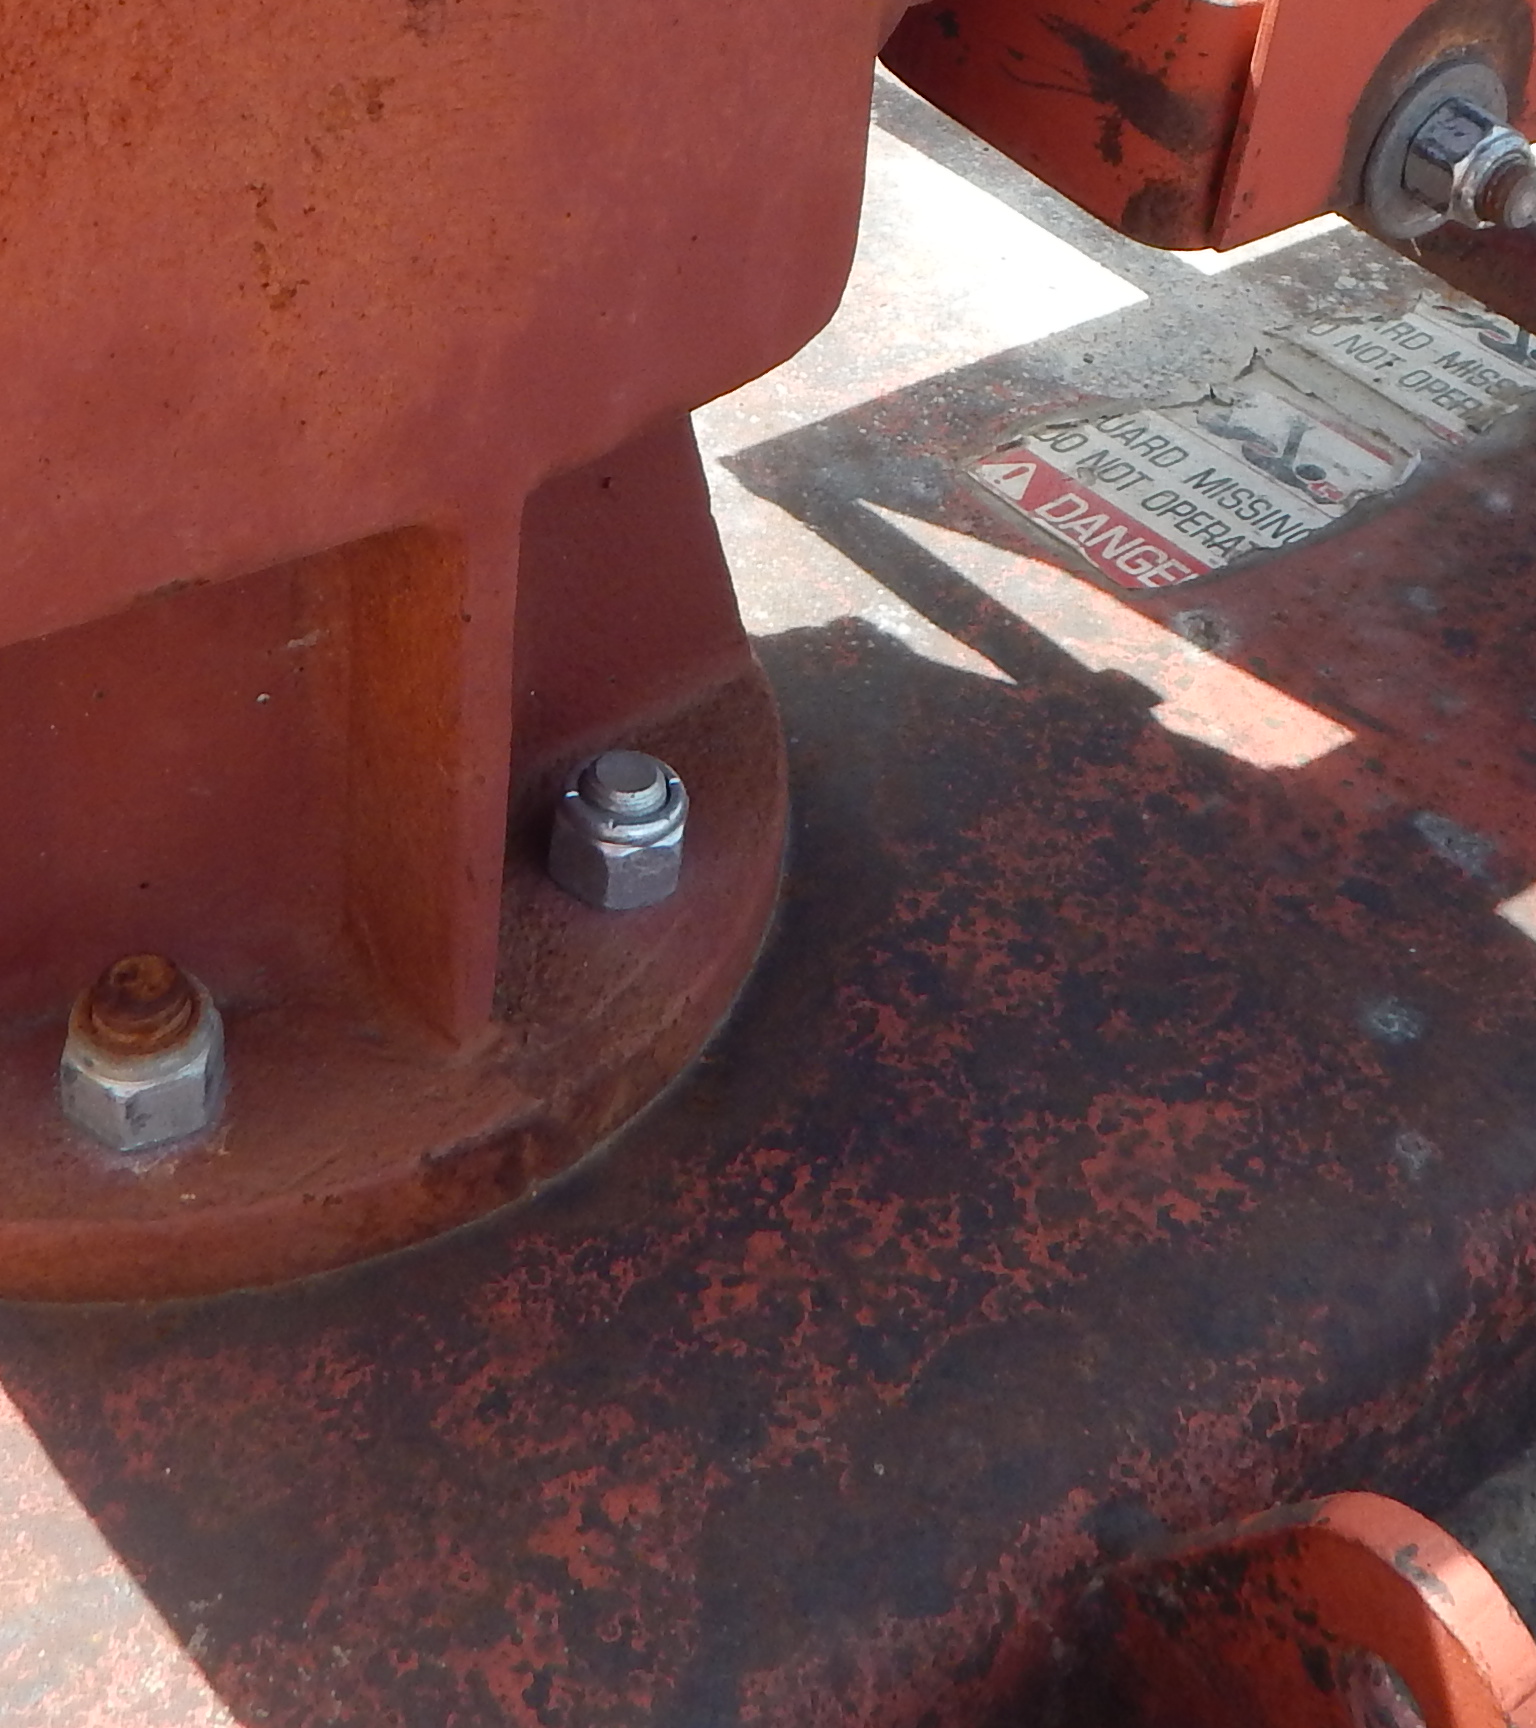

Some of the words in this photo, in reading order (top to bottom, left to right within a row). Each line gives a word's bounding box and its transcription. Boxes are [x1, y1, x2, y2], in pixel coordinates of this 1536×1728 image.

[1333, 334, 1407, 371] NOT
[1398, 369, 1484, 420] OPER
[1433, 351, 1536, 397] MISS
[1096, 414, 1189, 468] UARD
[1034, 492, 1198, 588] DANGE
[1076, 449, 1154, 491] NOT
[1141, 489, 1254, 558] OPERA
